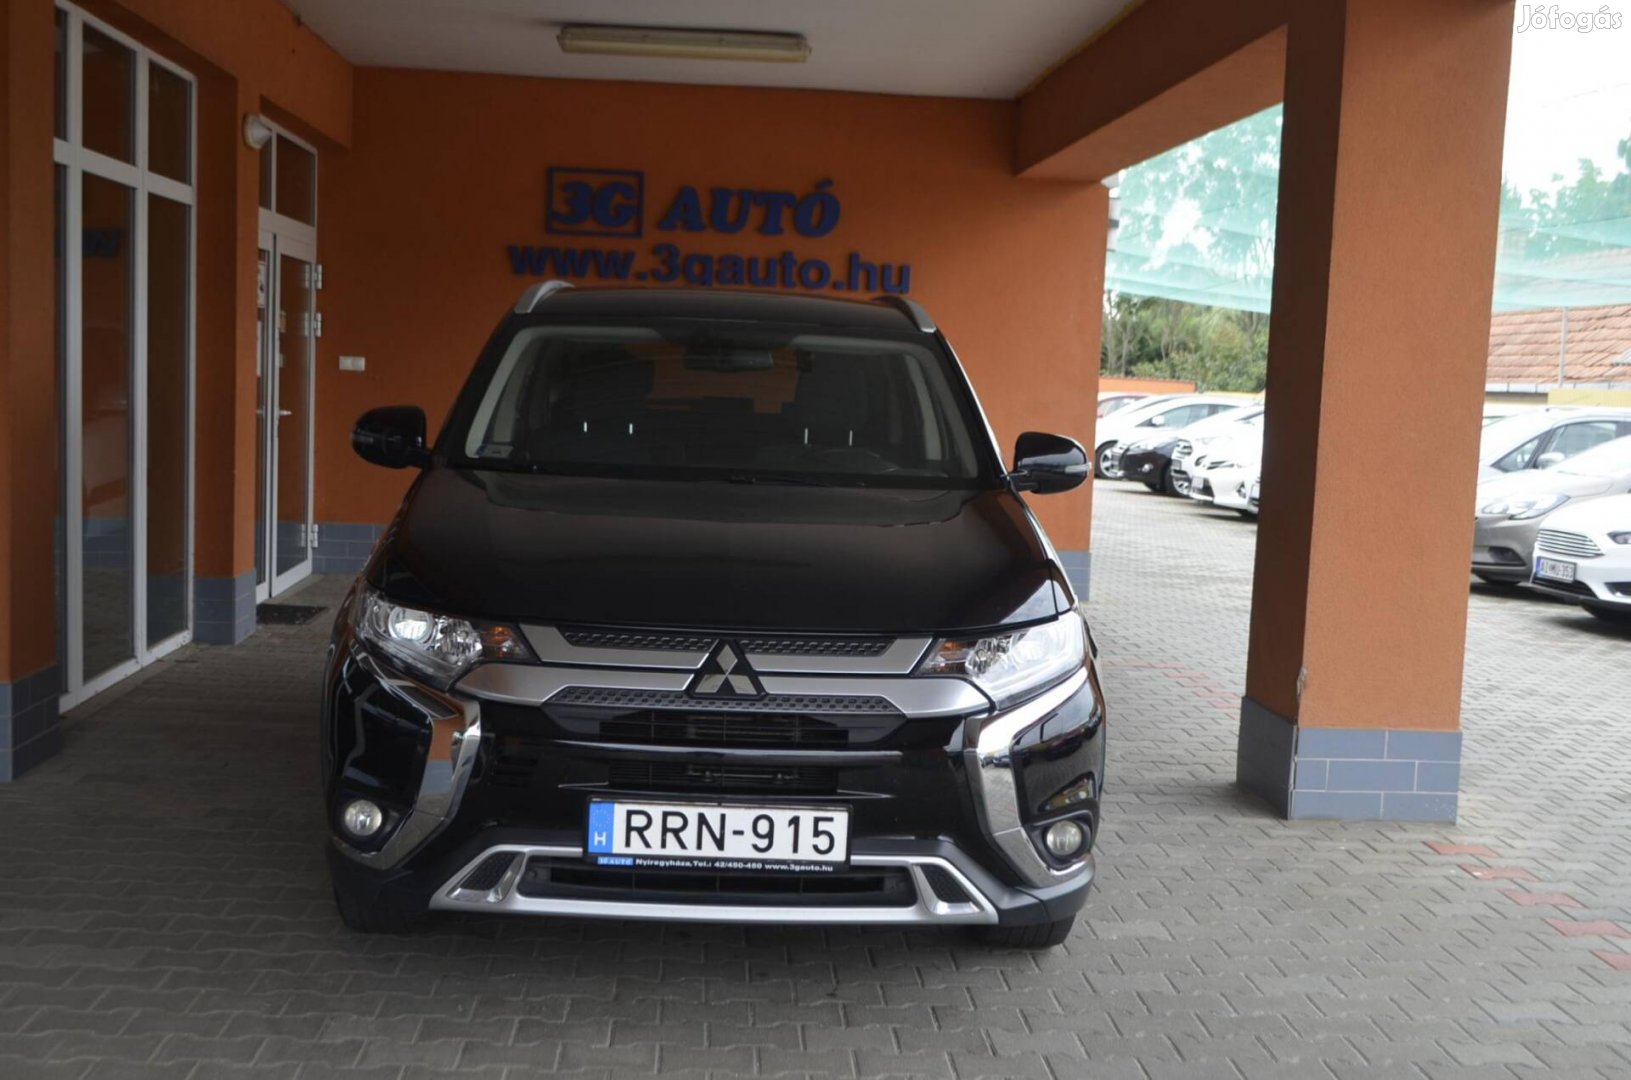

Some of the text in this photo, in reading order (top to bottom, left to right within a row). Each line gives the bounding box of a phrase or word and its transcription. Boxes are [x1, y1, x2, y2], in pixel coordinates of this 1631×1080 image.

[553, 178, 841, 238] 3G AUTÓ
[508, 243, 911, 293] www.3gauto.hu
[594, 832, 606, 846] H
[624, 809, 835, 855] RRN-915
